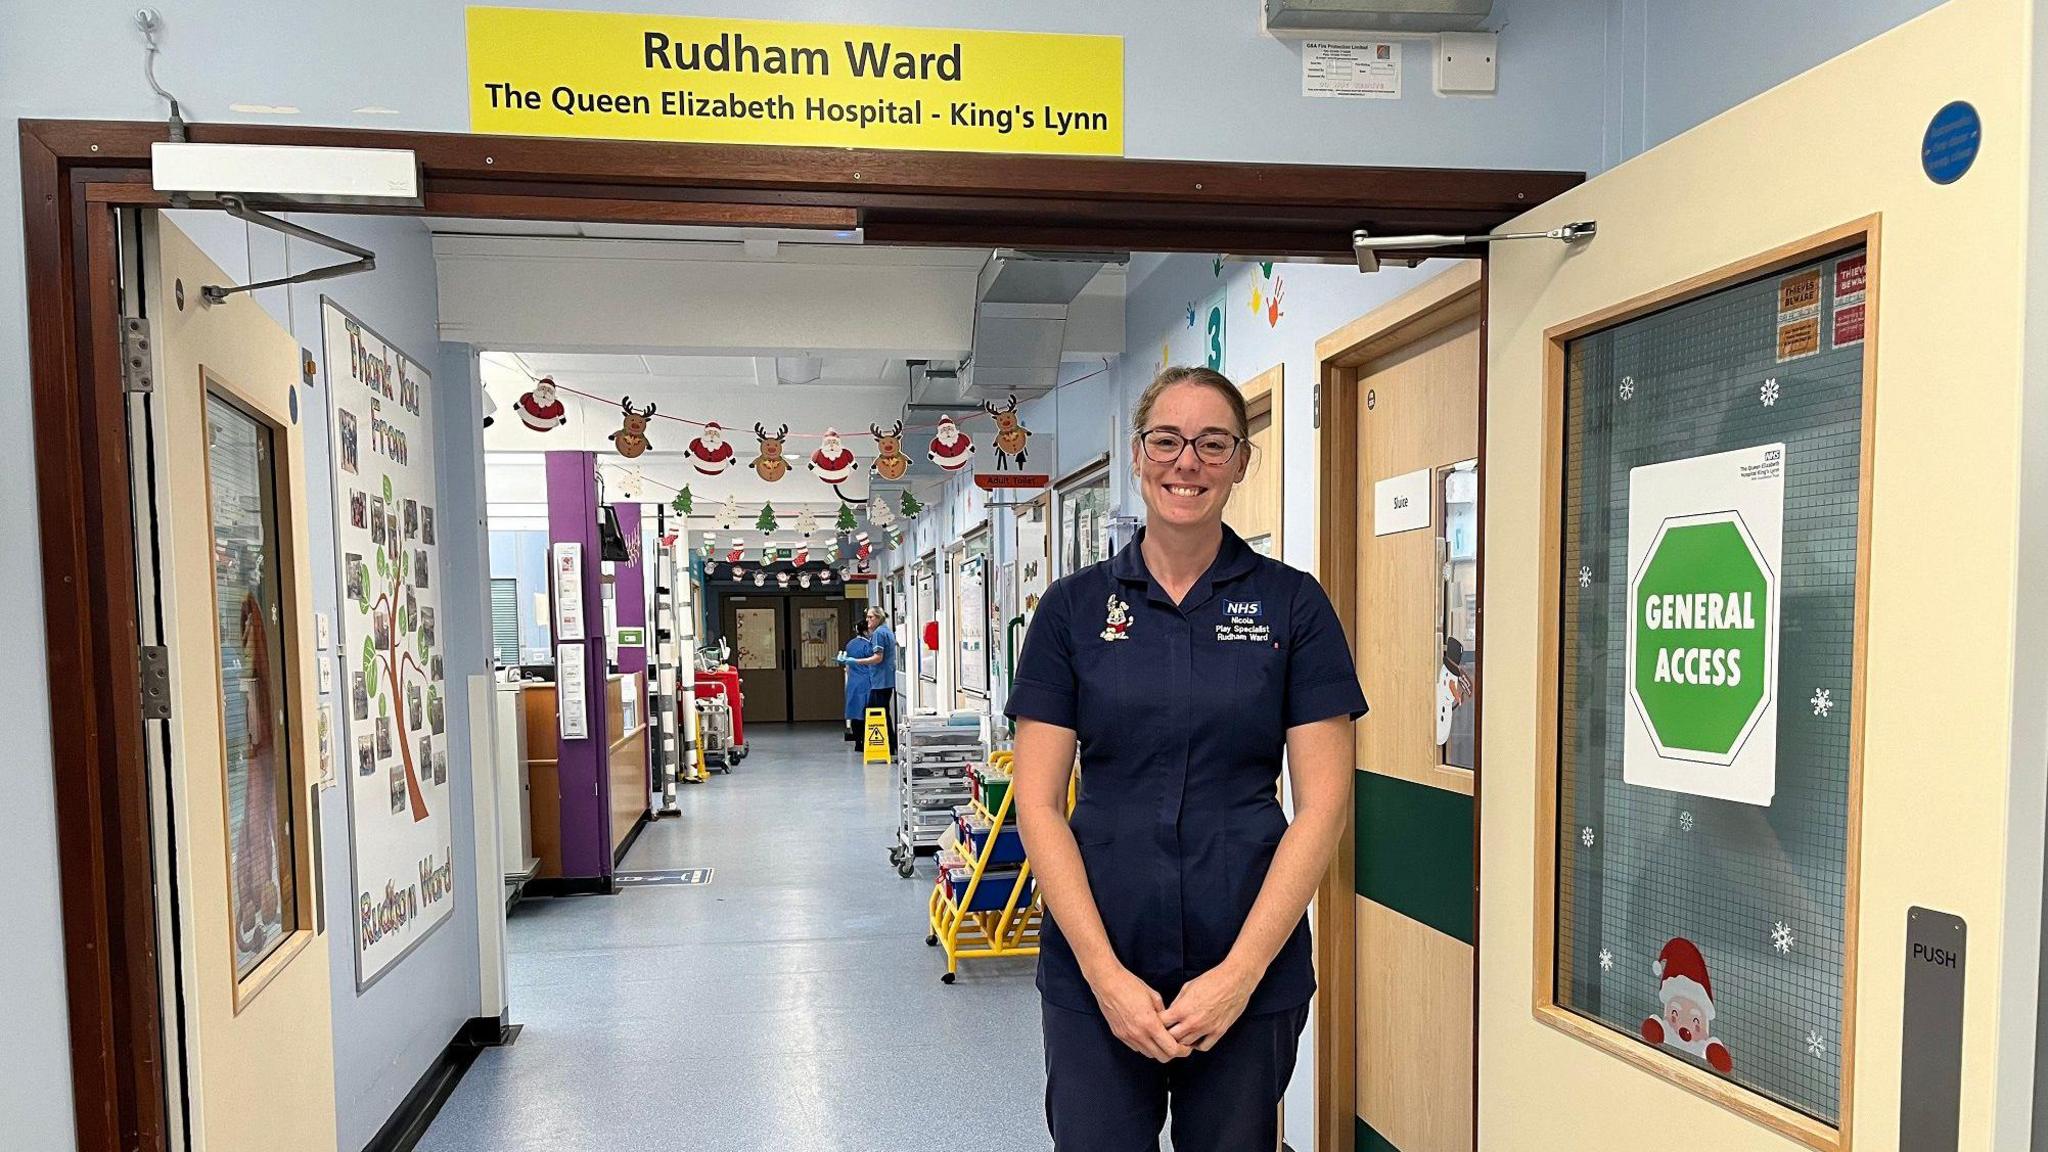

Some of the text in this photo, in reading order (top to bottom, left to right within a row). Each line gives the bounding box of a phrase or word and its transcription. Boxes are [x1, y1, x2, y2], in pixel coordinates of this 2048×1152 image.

[643, 31, 962, 81] Rudham Ward
[484, 83, 541, 109] The
[551, 86, 650, 115] Queen
[660, 91, 794, 120] Elizabeth
[806, 98, 921, 129] Hospital
[951, 102, 1035, 134] King's
[1045, 106, 1108, 136] Lynn
[1784, 280, 1815, 297] THIEVES
[1208, 306, 1221, 371] 3
[345, 317, 420, 417] Thank You
[371, 396, 408, 466] From
[1766, 450, 1780, 461] NHS
[987, 477, 1036, 485] Adult Toilet
[1227, 602, 1258, 614] NHS
[1231, 616, 1254, 624] Nicola
[1645, 591, 1755, 630] GENERAL
[1215, 625, 1270, 634] Play Specialist
[1217, 633, 1269, 642] Rudham Ward
[1654, 647, 1741, 687] ACCESS
[1913, 943, 1957, 969] PUSH
